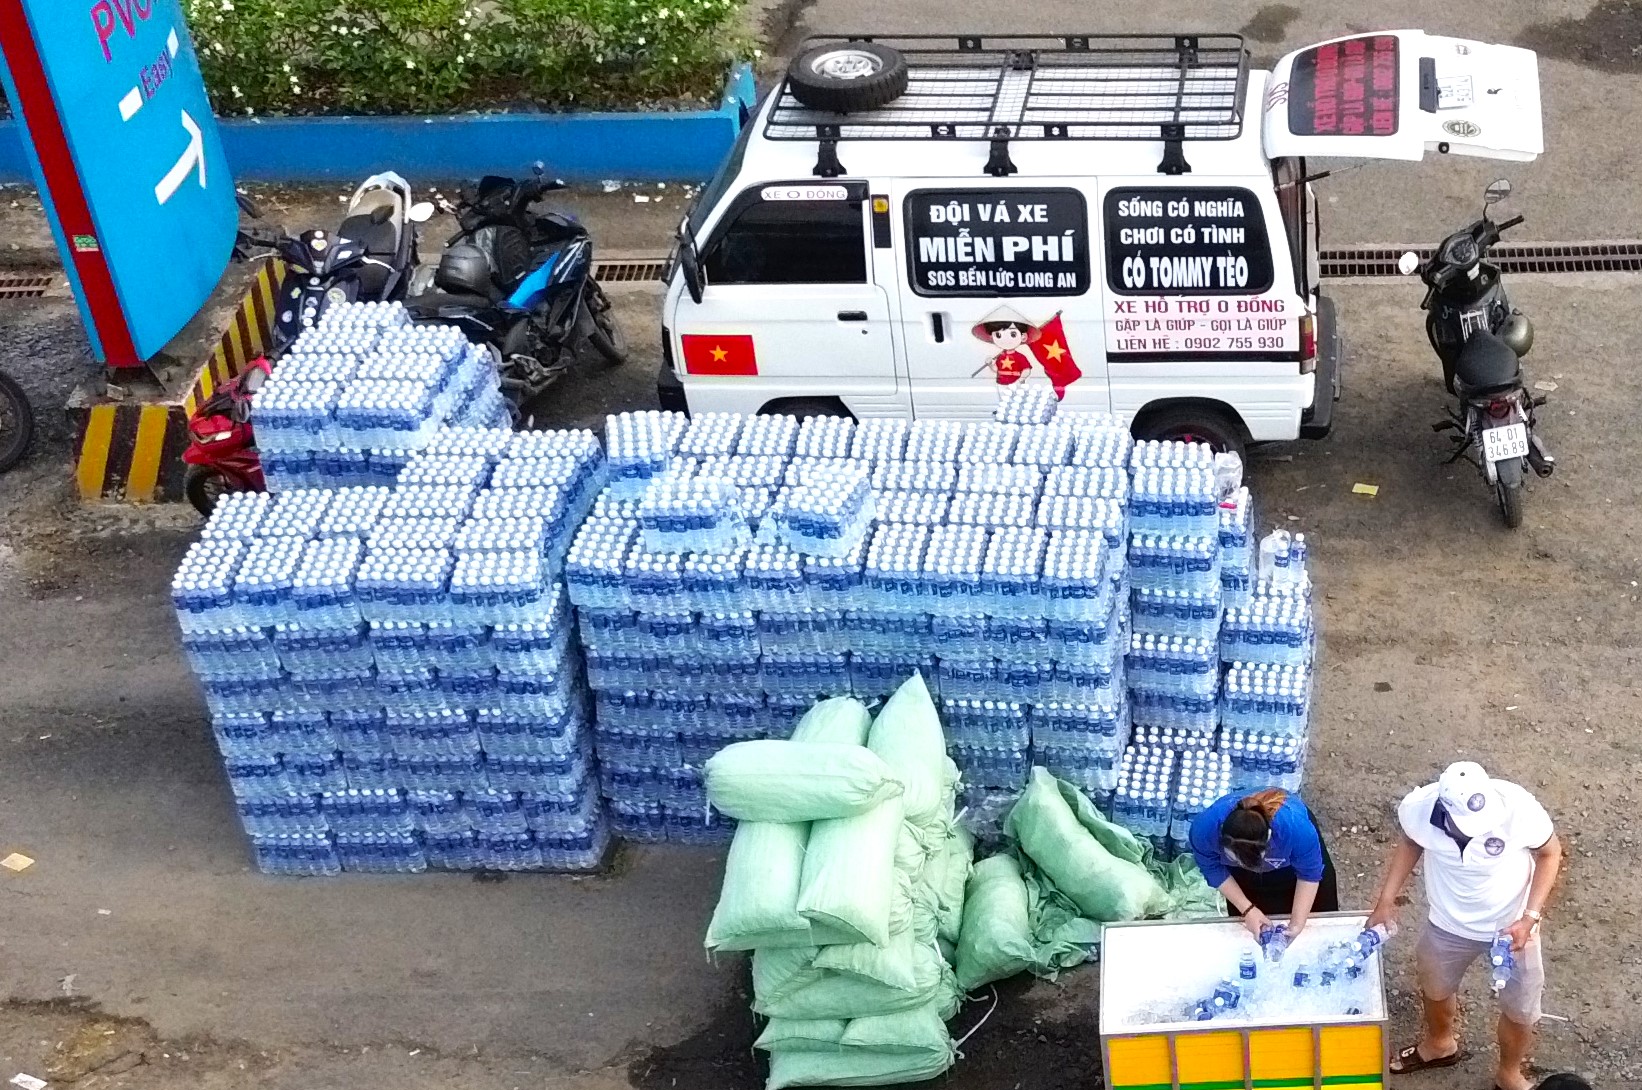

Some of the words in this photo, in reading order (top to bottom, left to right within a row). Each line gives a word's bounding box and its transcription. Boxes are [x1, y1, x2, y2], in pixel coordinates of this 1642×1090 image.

[764, 191, 781, 199] XE
[929, 200, 970, 225] ĐỘI
[977, 200, 1011, 223] VÁ
[1017, 204, 1048, 223] XE
[1118, 196, 1163, 217] SỐNG
[1167, 197, 1190, 217] CÓ
[1194, 197, 1245, 217] NGHĨA
[1120, 226, 1165, 244] CHƠI
[1170, 224, 1196, 244] CÓ
[1201, 224, 1245, 244] TÌNH
[919, 228, 995, 263] MIỄN
[1002, 229, 1075, 262] PHÍ
[928, 270, 955, 286] SOS
[958, 266, 986, 286] BẾN
[1017, 271, 1053, 288] LONG
[1057, 271, 1077, 288] AN
[1150, 256, 1213, 288] TOMMY
[1216, 250, 1249, 288] TÈO
[1114, 300, 1137, 313] XE
[1175, 298, 1210, 316] TRỢ
[1145, 317, 1161, 331] LÀ
[1166, 318, 1196, 331] GIÚP
[1237, 317, 1252, 331] LÀ
[1257, 316, 1287, 331] GIÚP
[1184, 337, 1221, 349] 0902
[1227, 337, 1252, 349] 755
[1258, 337, 1285, 349] 930
